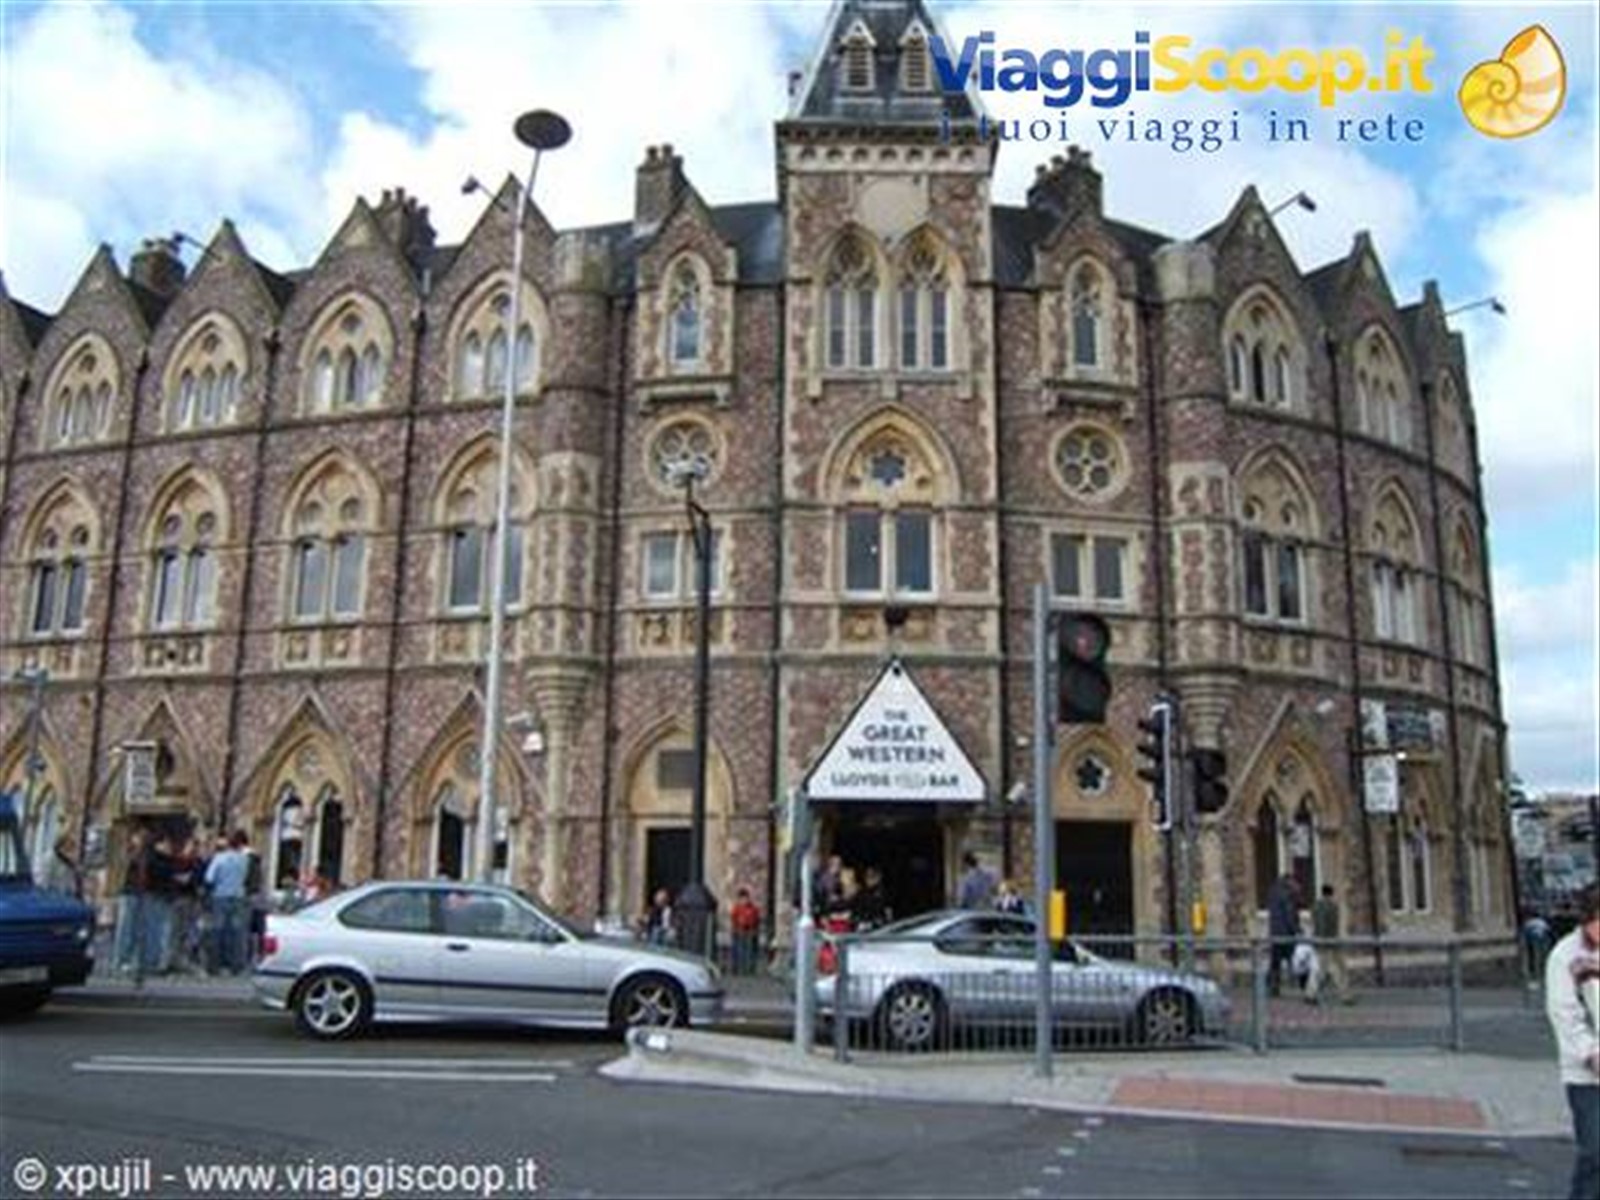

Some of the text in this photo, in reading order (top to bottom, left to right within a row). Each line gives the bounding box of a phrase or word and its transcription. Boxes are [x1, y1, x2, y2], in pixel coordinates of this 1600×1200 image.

[883, 709, 908, 722] THE
[863, 724, 928, 742] GREAT
[847, 746, 946, 763] WESTERN
[929, 773, 960, 787] BAR
